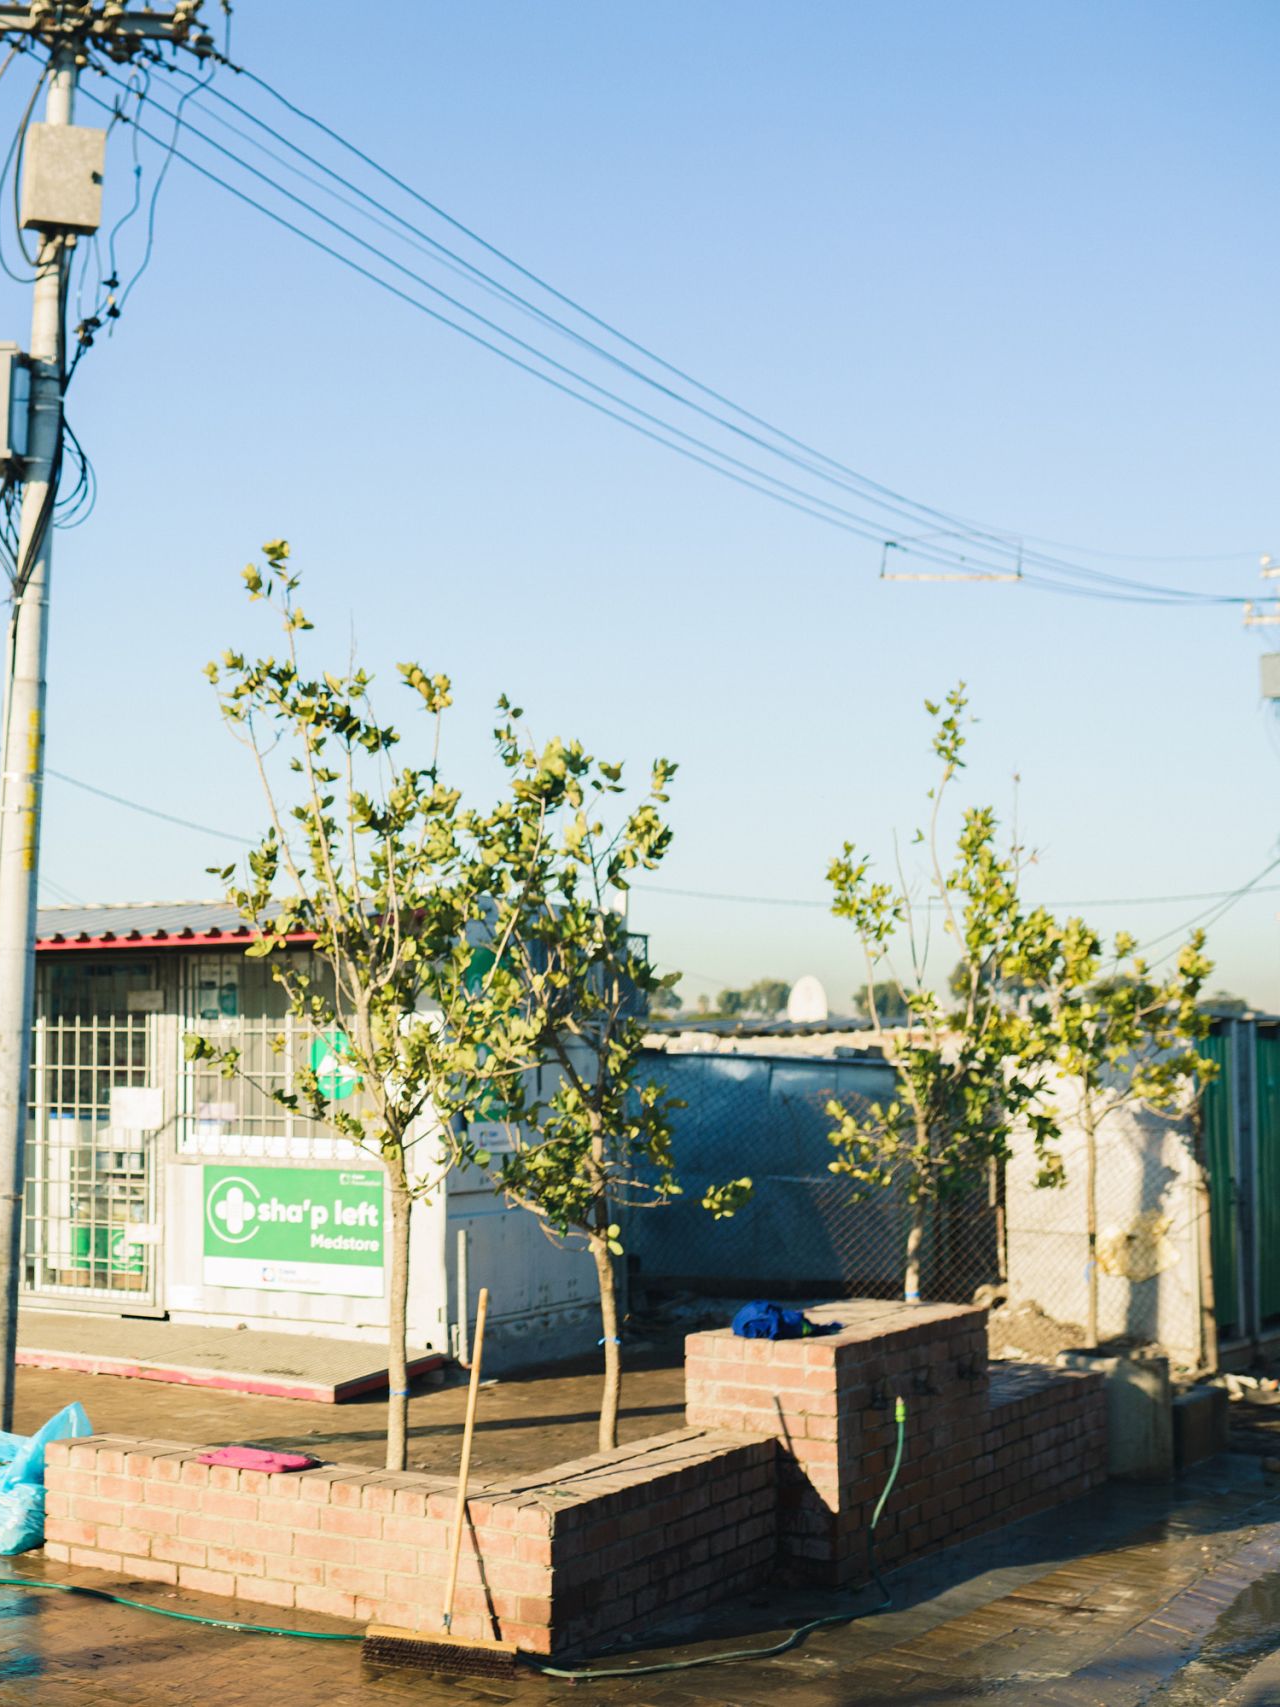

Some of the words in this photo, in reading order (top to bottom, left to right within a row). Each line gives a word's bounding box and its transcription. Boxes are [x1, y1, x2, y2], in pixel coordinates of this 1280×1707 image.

[258, 1197, 328, 1231] sha'p
[334, 1199, 379, 1228] left
[310, 1233, 380, 1252] Medstore
